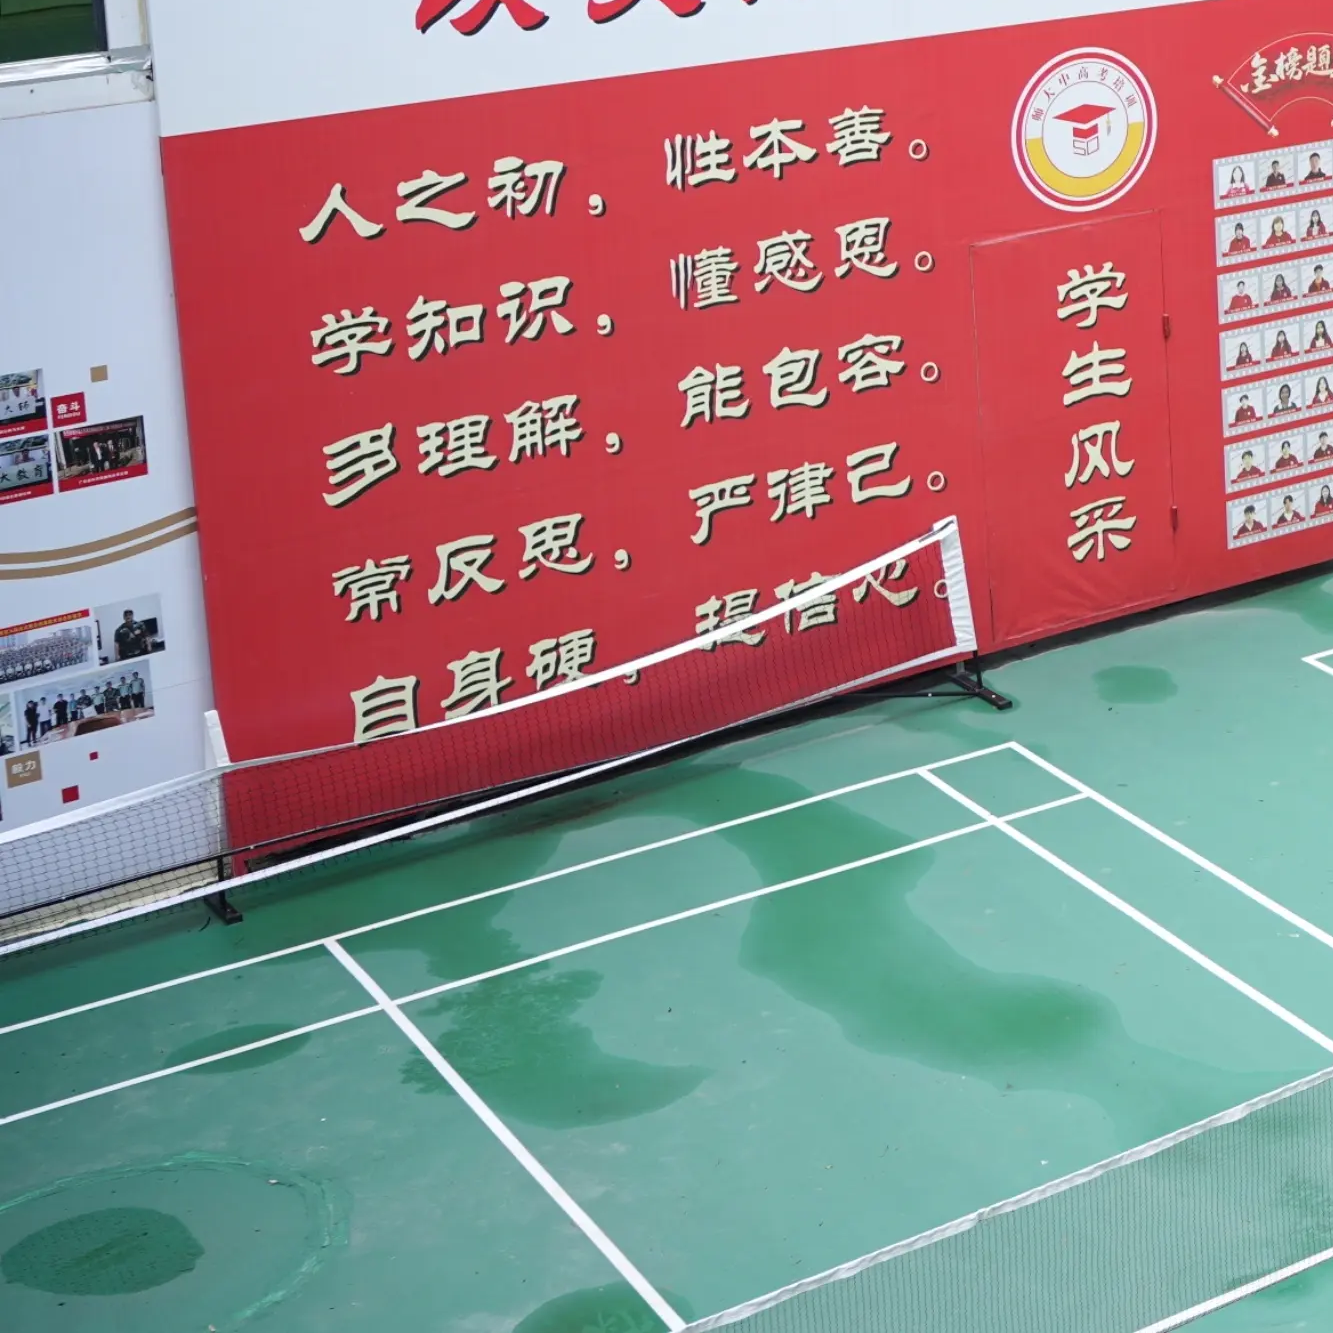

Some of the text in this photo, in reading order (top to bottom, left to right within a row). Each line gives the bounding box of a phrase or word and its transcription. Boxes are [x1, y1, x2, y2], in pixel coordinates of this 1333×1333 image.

[1032, 67, 1137, 121] 师大中高考培训
[1056, 261, 1137, 562] 学生风采
